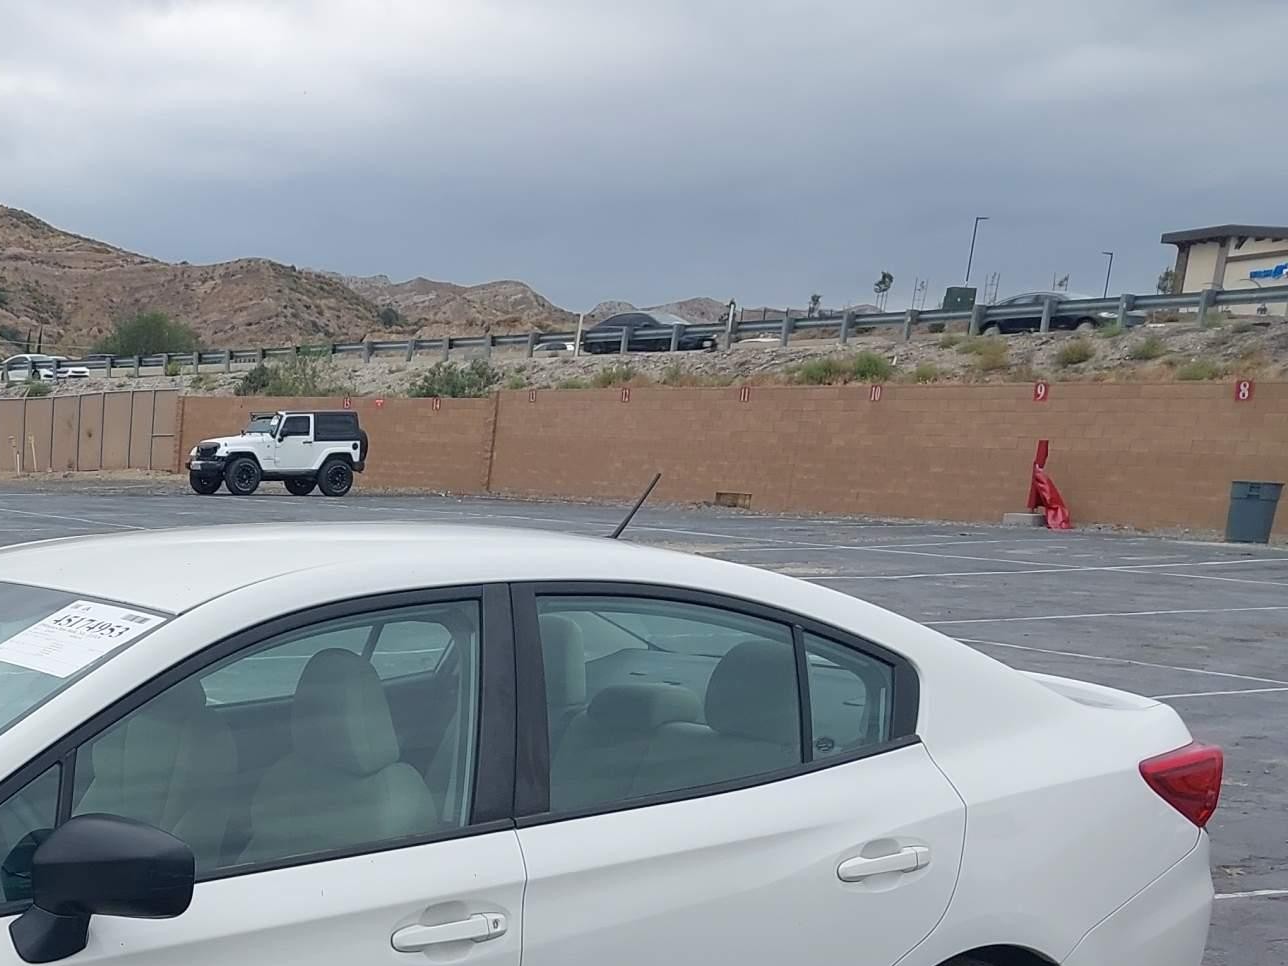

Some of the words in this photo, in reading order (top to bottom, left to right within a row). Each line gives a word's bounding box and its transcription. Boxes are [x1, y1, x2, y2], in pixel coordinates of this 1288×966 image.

[871, 386, 881, 401] 10
[1037, 383, 1045, 400] 9
[1239, 381, 1250, 400] 8
[53, 614, 130, 638] 45174953
